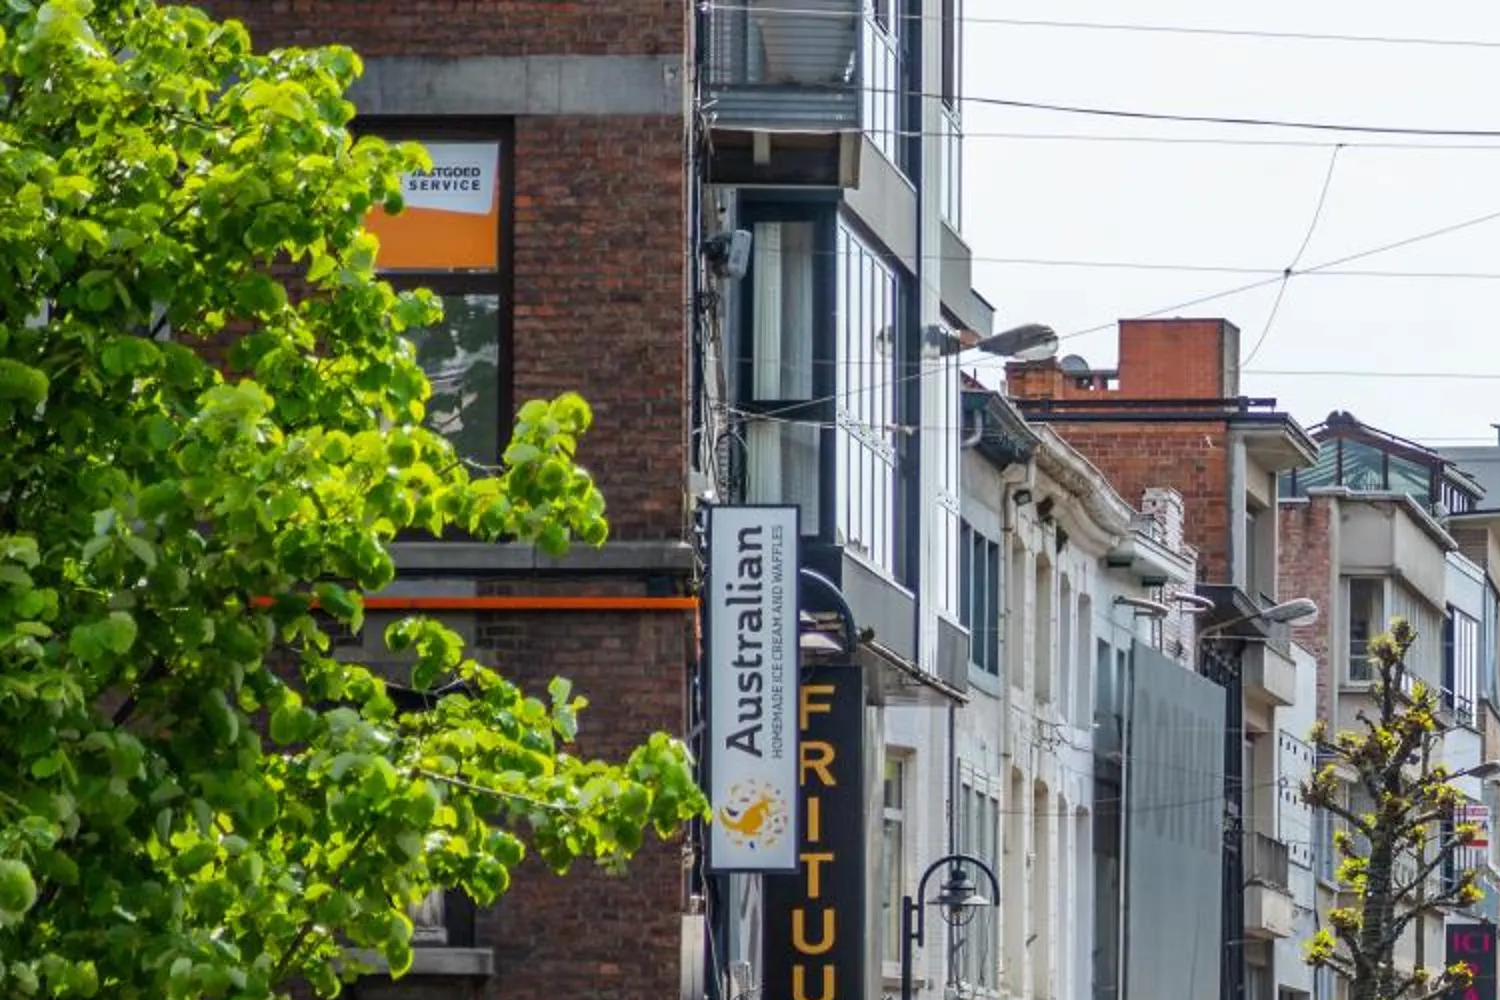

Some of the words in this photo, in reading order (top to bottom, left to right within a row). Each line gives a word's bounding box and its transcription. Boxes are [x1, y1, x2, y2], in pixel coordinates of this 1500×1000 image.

[407, 179, 481, 191] SERVICE
[771, 525, 785, 584] WAFFLES
[771, 586, 785, 614] AND
[725, 525, 764, 759] Australian
[771, 617, 785, 662] CREAM
[771, 664, 785, 683] ICE
[771, 686, 785, 759] HOMEMADE
